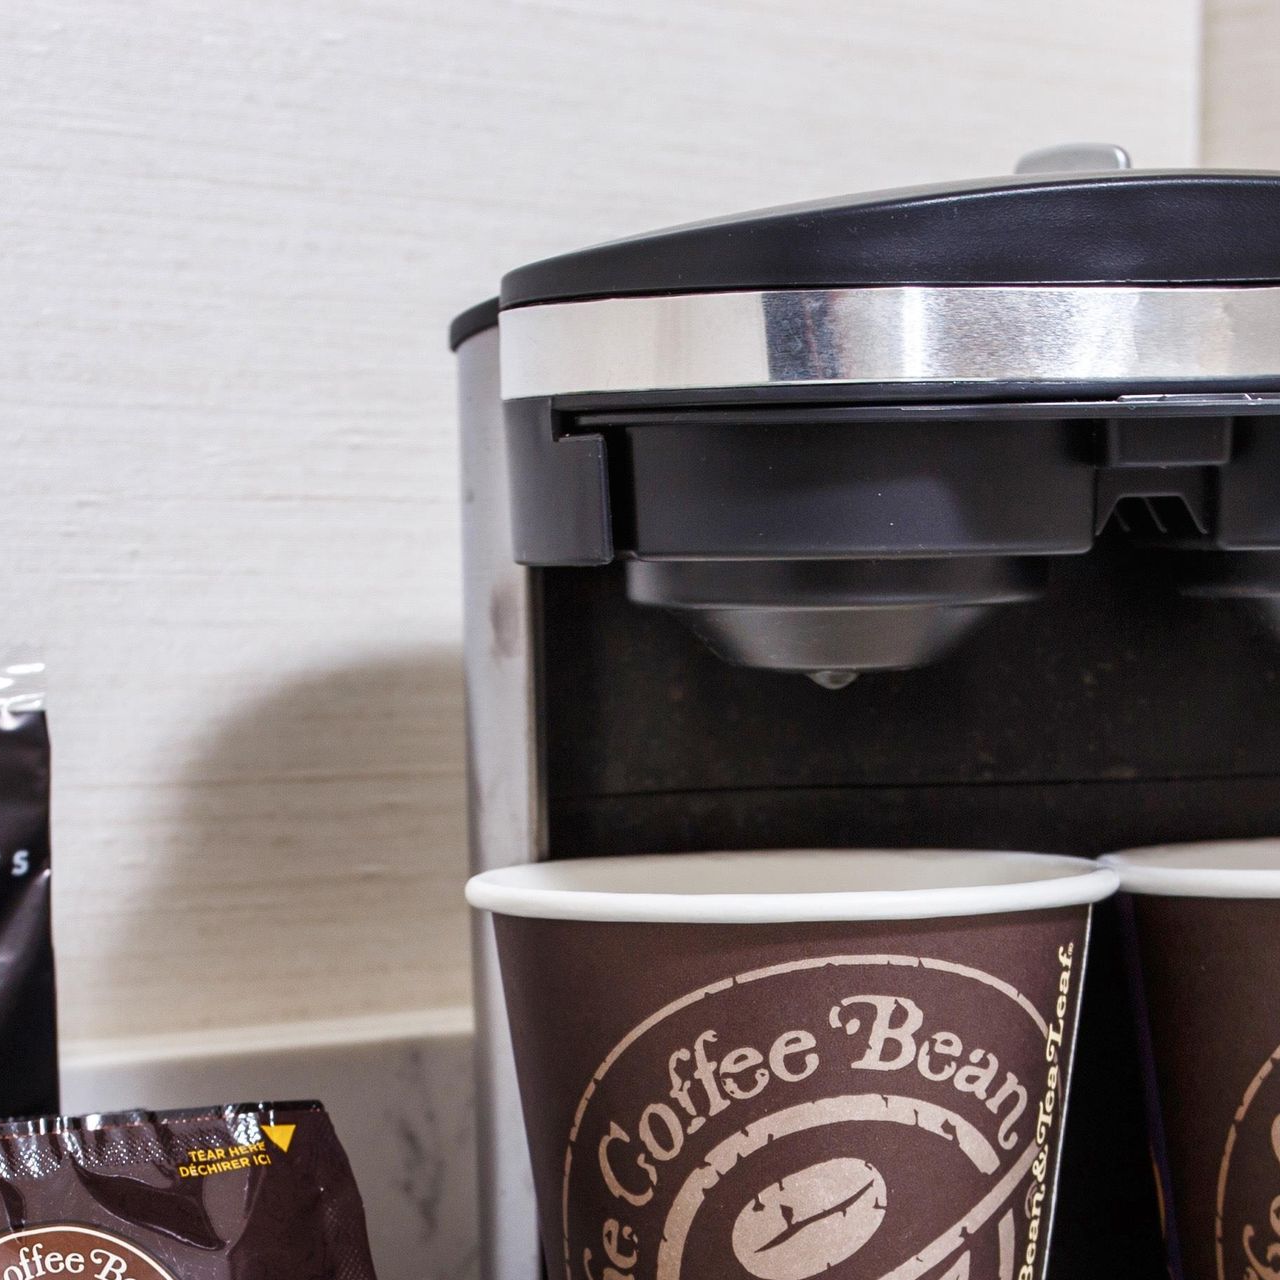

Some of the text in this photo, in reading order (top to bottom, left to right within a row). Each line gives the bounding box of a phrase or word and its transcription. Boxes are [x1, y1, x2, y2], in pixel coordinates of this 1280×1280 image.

[598, 1027, 821, 1209] Coffee
[829, 993, 1030, 1151] Bean
[1036, 1063, 1058, 1145] Tea
[178, 1153, 272, 1178] DÉCHIRER ICI
[188, 1141, 267, 1163] TEAR HERE
[1032, 1144, 1049, 1183] &
